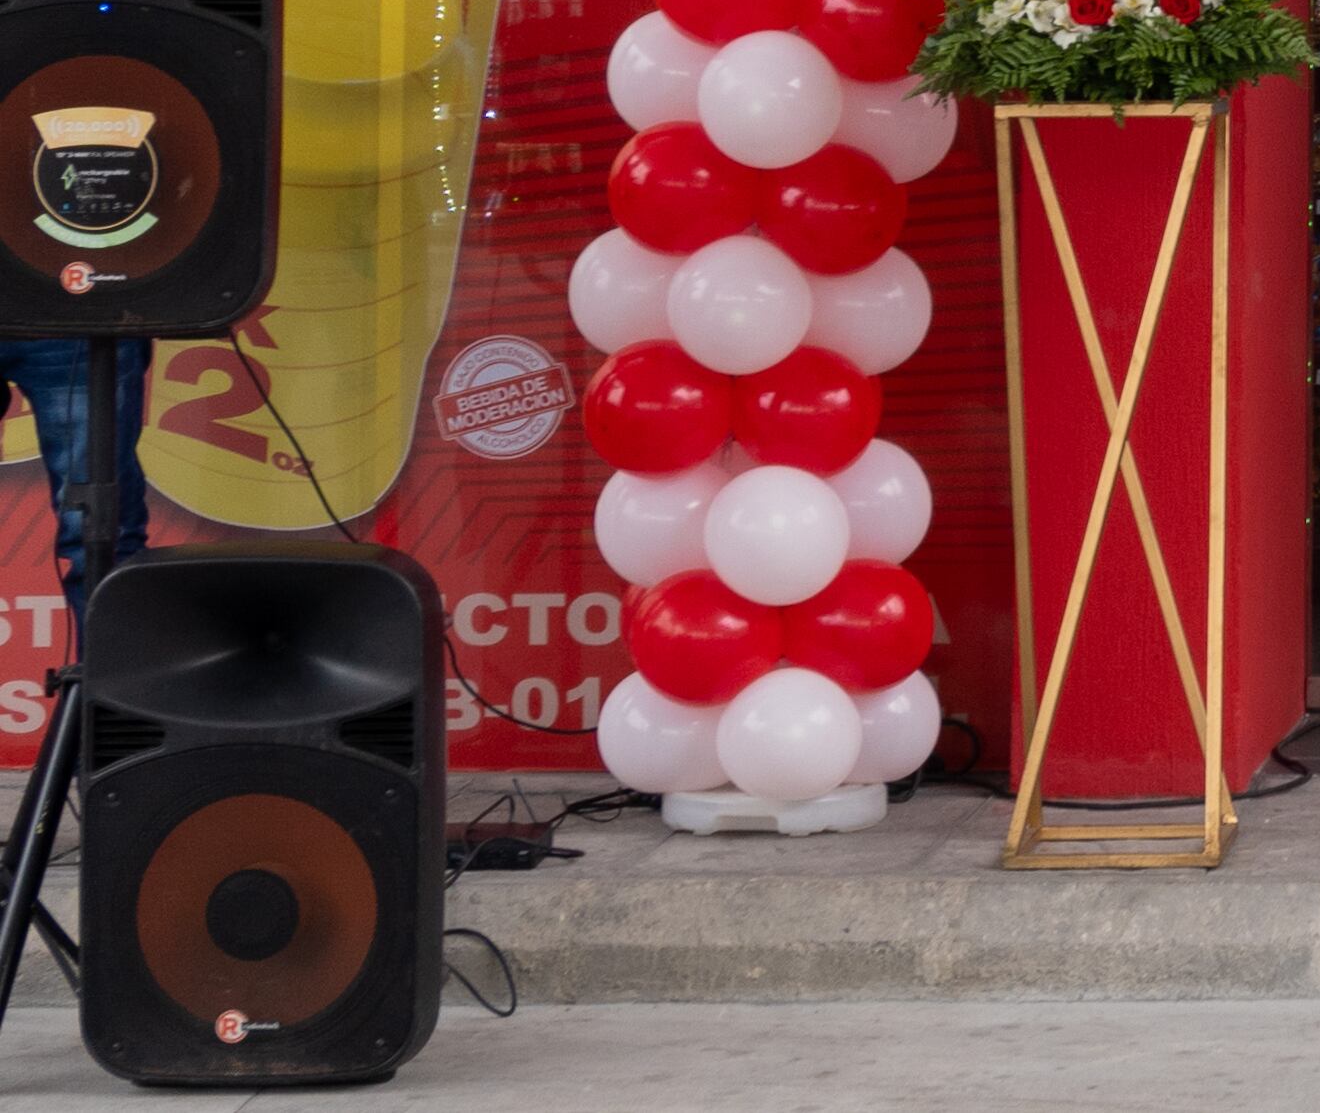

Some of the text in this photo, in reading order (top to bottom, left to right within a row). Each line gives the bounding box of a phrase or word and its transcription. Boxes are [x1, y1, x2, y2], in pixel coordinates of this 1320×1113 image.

[456, 376, 549, 412] BEBIDA DE
[442, 592, 621, 647] CTO
